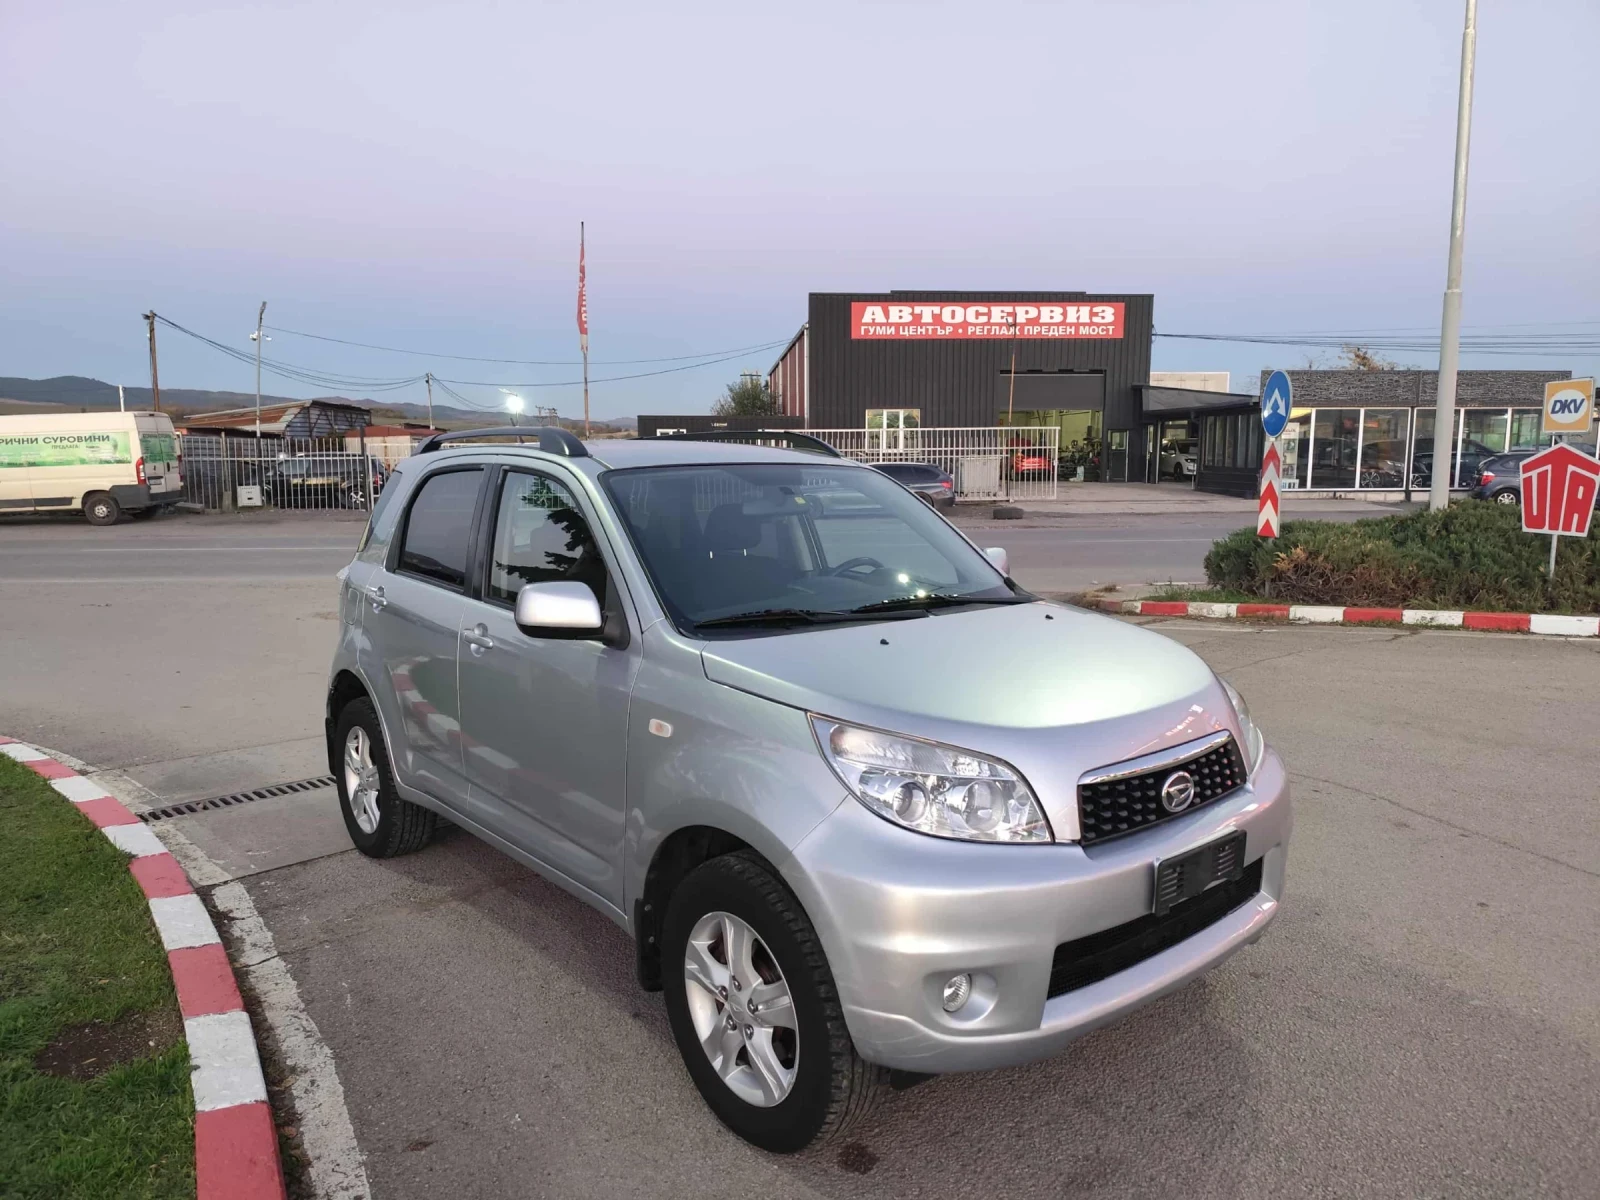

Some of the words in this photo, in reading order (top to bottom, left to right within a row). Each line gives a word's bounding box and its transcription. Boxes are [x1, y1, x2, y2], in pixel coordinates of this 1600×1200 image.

[861, 305, 1115, 323] АВТОСЕРВИЗ
[861, 326, 896, 336] ГУМИ
[900, 326, 954, 337] ЦЕНТЪР
[967, 326, 1020, 336] РЕГЛАЖ
[1024, 326, 1075, 337] ПРЕДЕН
[1079, 325, 1115, 336] МОСТ
[1551, 398, 1586, 415] DKV
[42, 435, 110, 444] СУРОВИНИ
[1522, 446, 1600, 533] UTA
